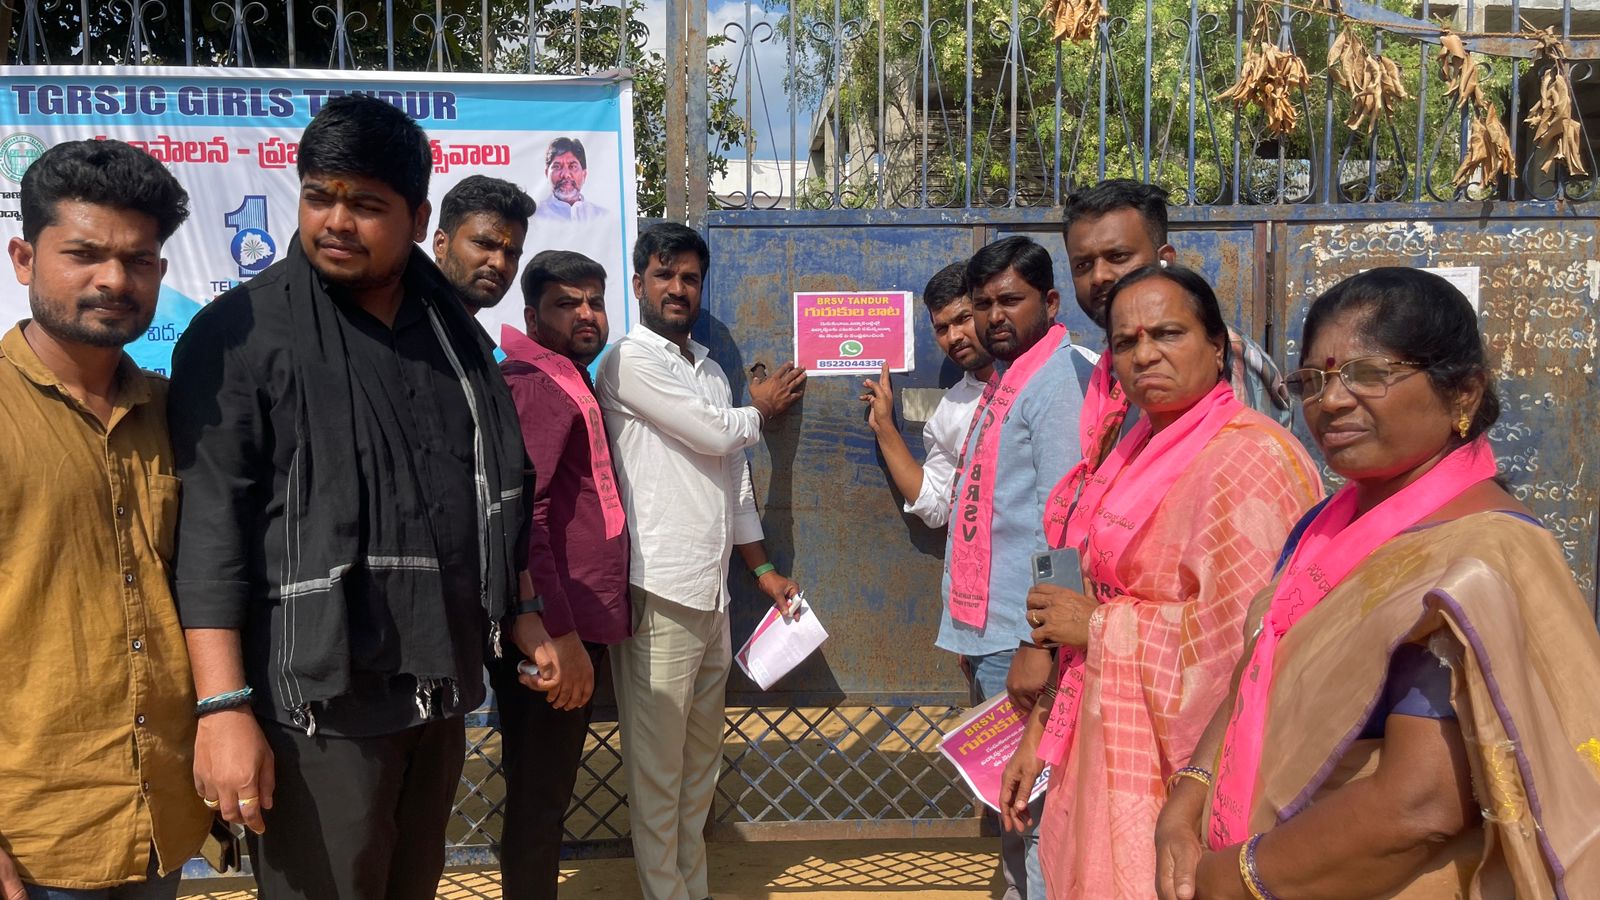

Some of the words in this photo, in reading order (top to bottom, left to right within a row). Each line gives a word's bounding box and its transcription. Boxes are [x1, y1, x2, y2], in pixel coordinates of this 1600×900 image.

[11, 84, 166, 115] TGRSJC
[177, 86, 294, 117] GIRLS
[817, 296, 844, 305] BRSV
[848, 296, 889, 305] TANDUR
[964, 711, 996, 737] BRSV
